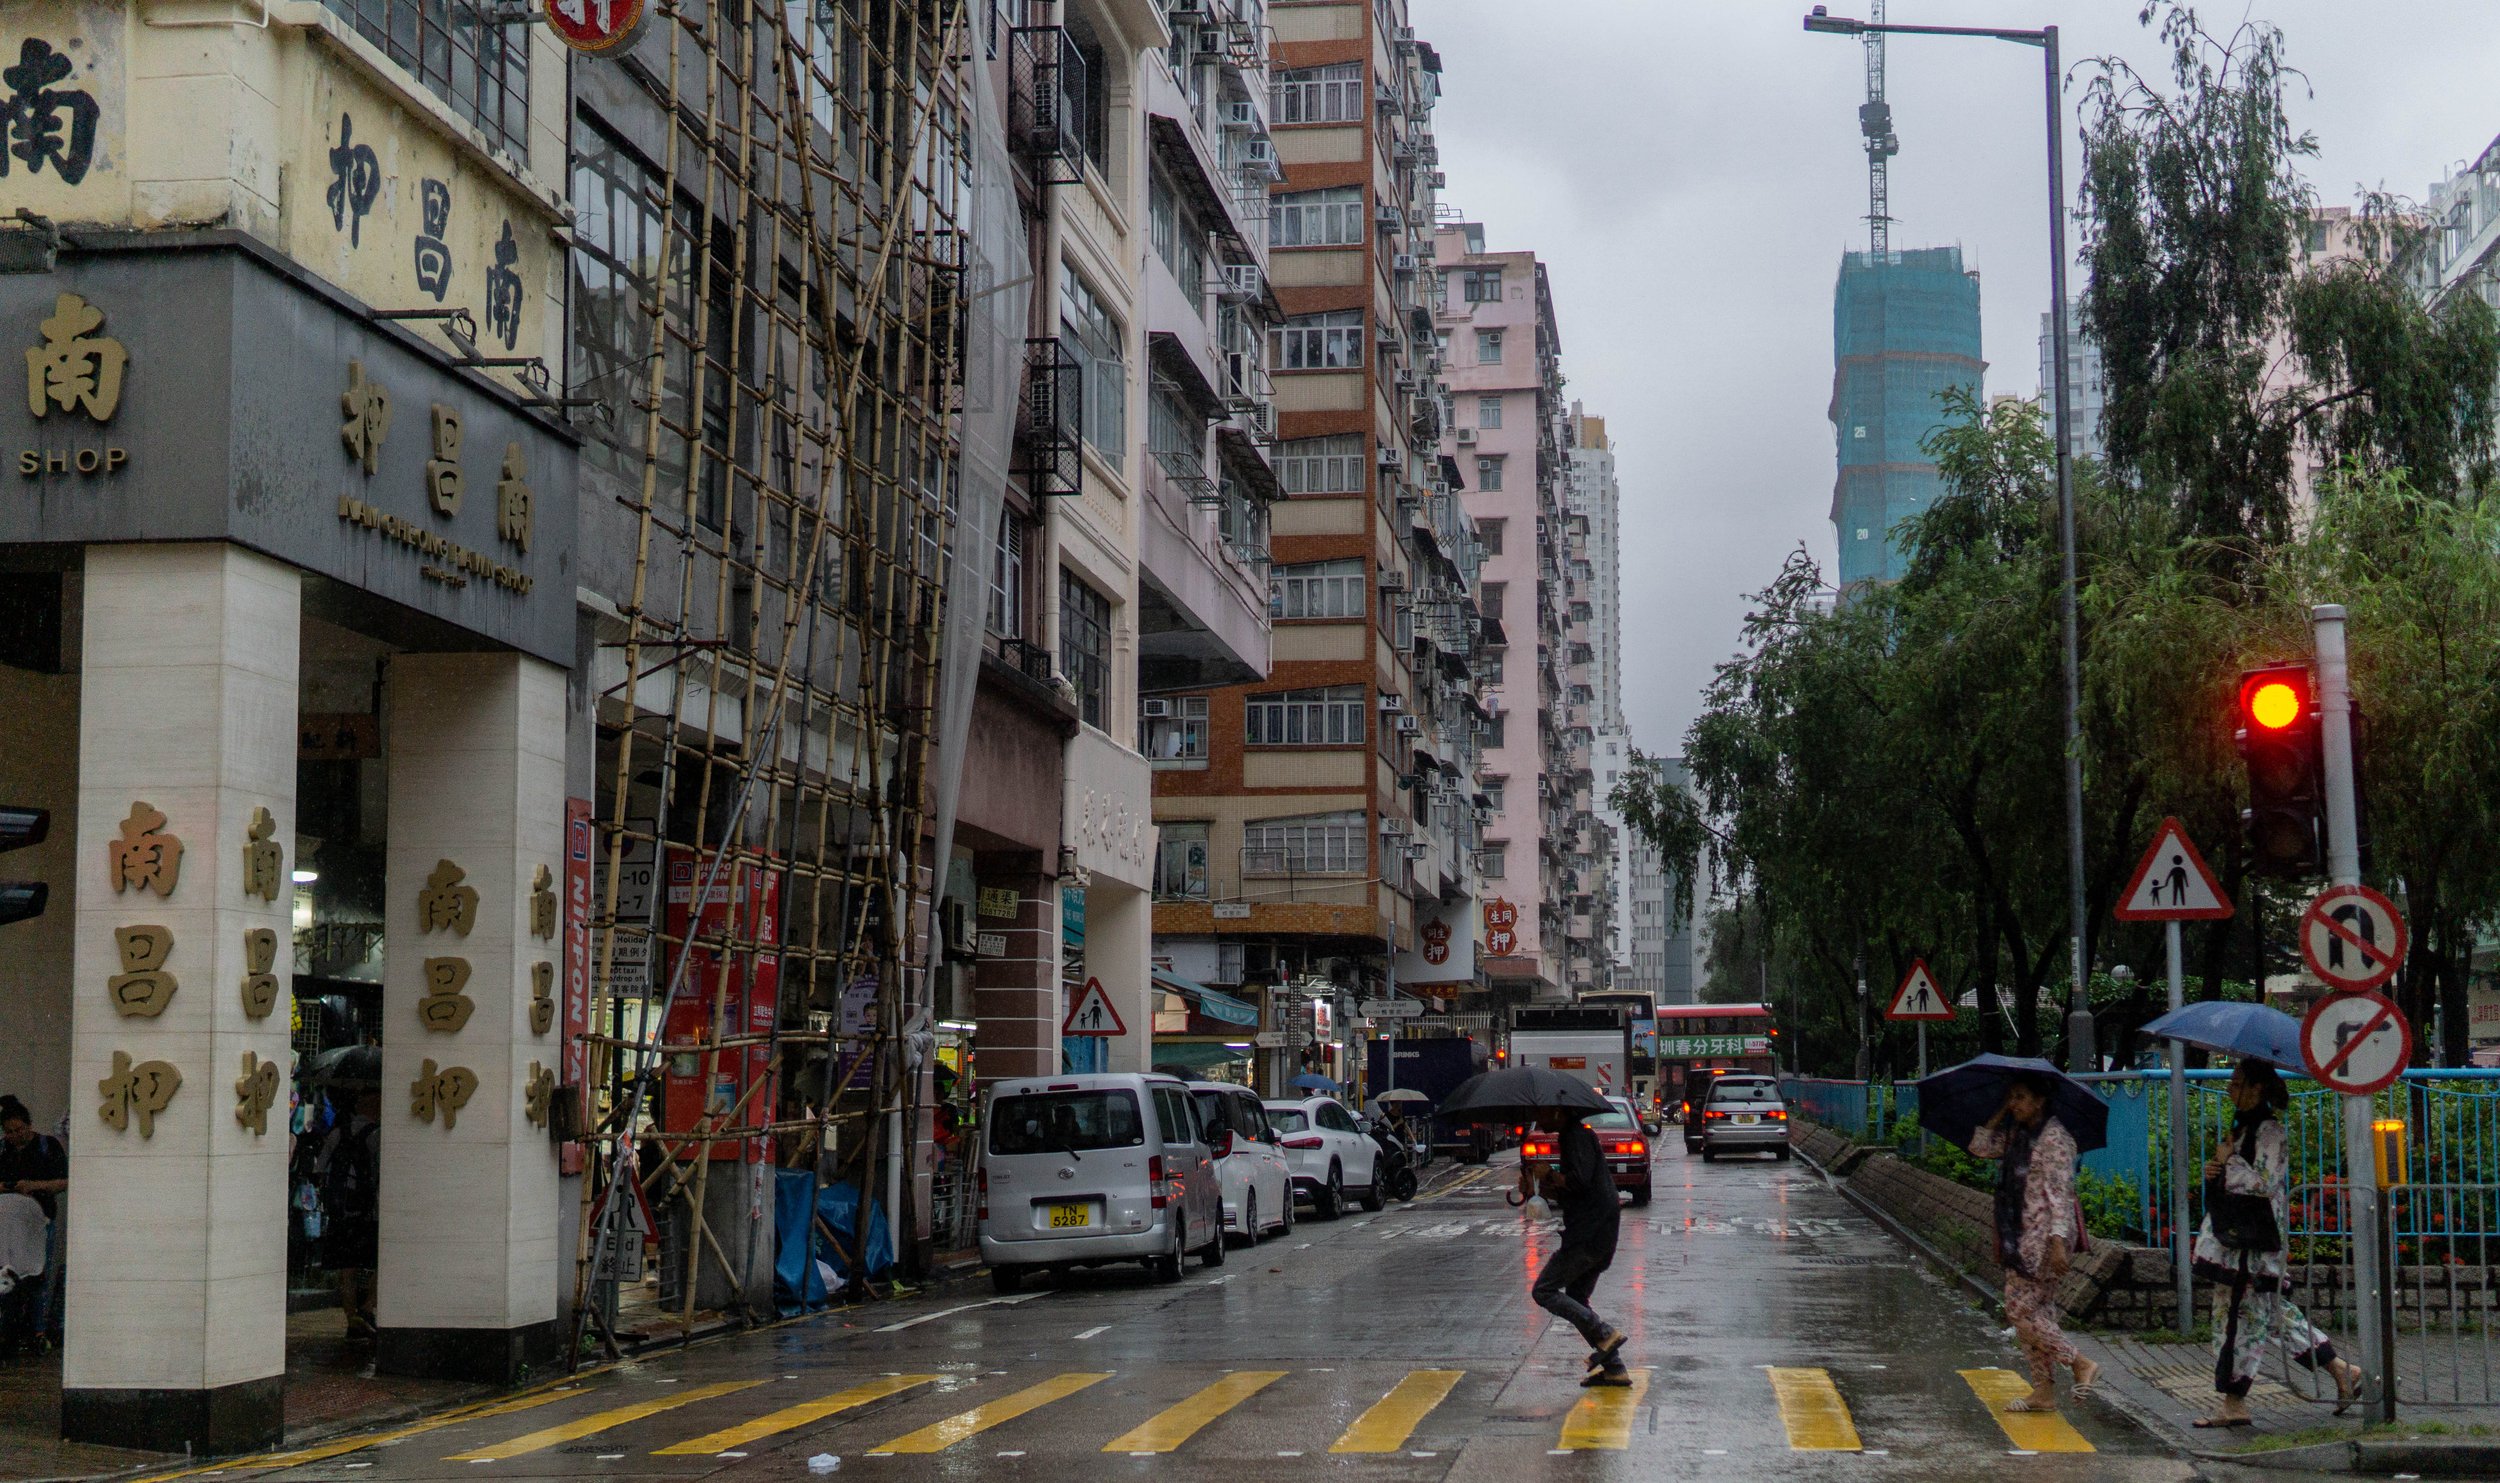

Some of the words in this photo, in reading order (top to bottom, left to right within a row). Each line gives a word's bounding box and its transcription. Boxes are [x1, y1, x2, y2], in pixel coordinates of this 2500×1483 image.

[25, 295, 128, 421] 南
[1854, 426, 1866, 438] 25
[19, 448, 127, 474] SHOP
[339, 495, 379, 529] NAM
[380, 513, 448, 558] CHEONG
[448, 542, 494, 579] PAWN
[495, 564, 533, 595] SHOP
[1857, 529, 1869, 540] 20
[572, 875, 586, 1024] NIPPON
[617, 936, 648, 944] Holiday
[1491, 930, 1511, 952] 押
[1427, 943, 1445, 961] 押
[99, 800, 184, 1140] 南昌押
[236, 806, 283, 1136] 南昌押
[411, 858, 480, 1129] 南昌押
[526, 863, 557, 1129] 南昌押
[1376, 1001, 1390, 1009] Apliu
[1660, 1037, 1743, 1056] 圳春分牙科
[1053, 1214, 1086, 1227] 5287
[1061, 1205, 1078, 1216] TN
